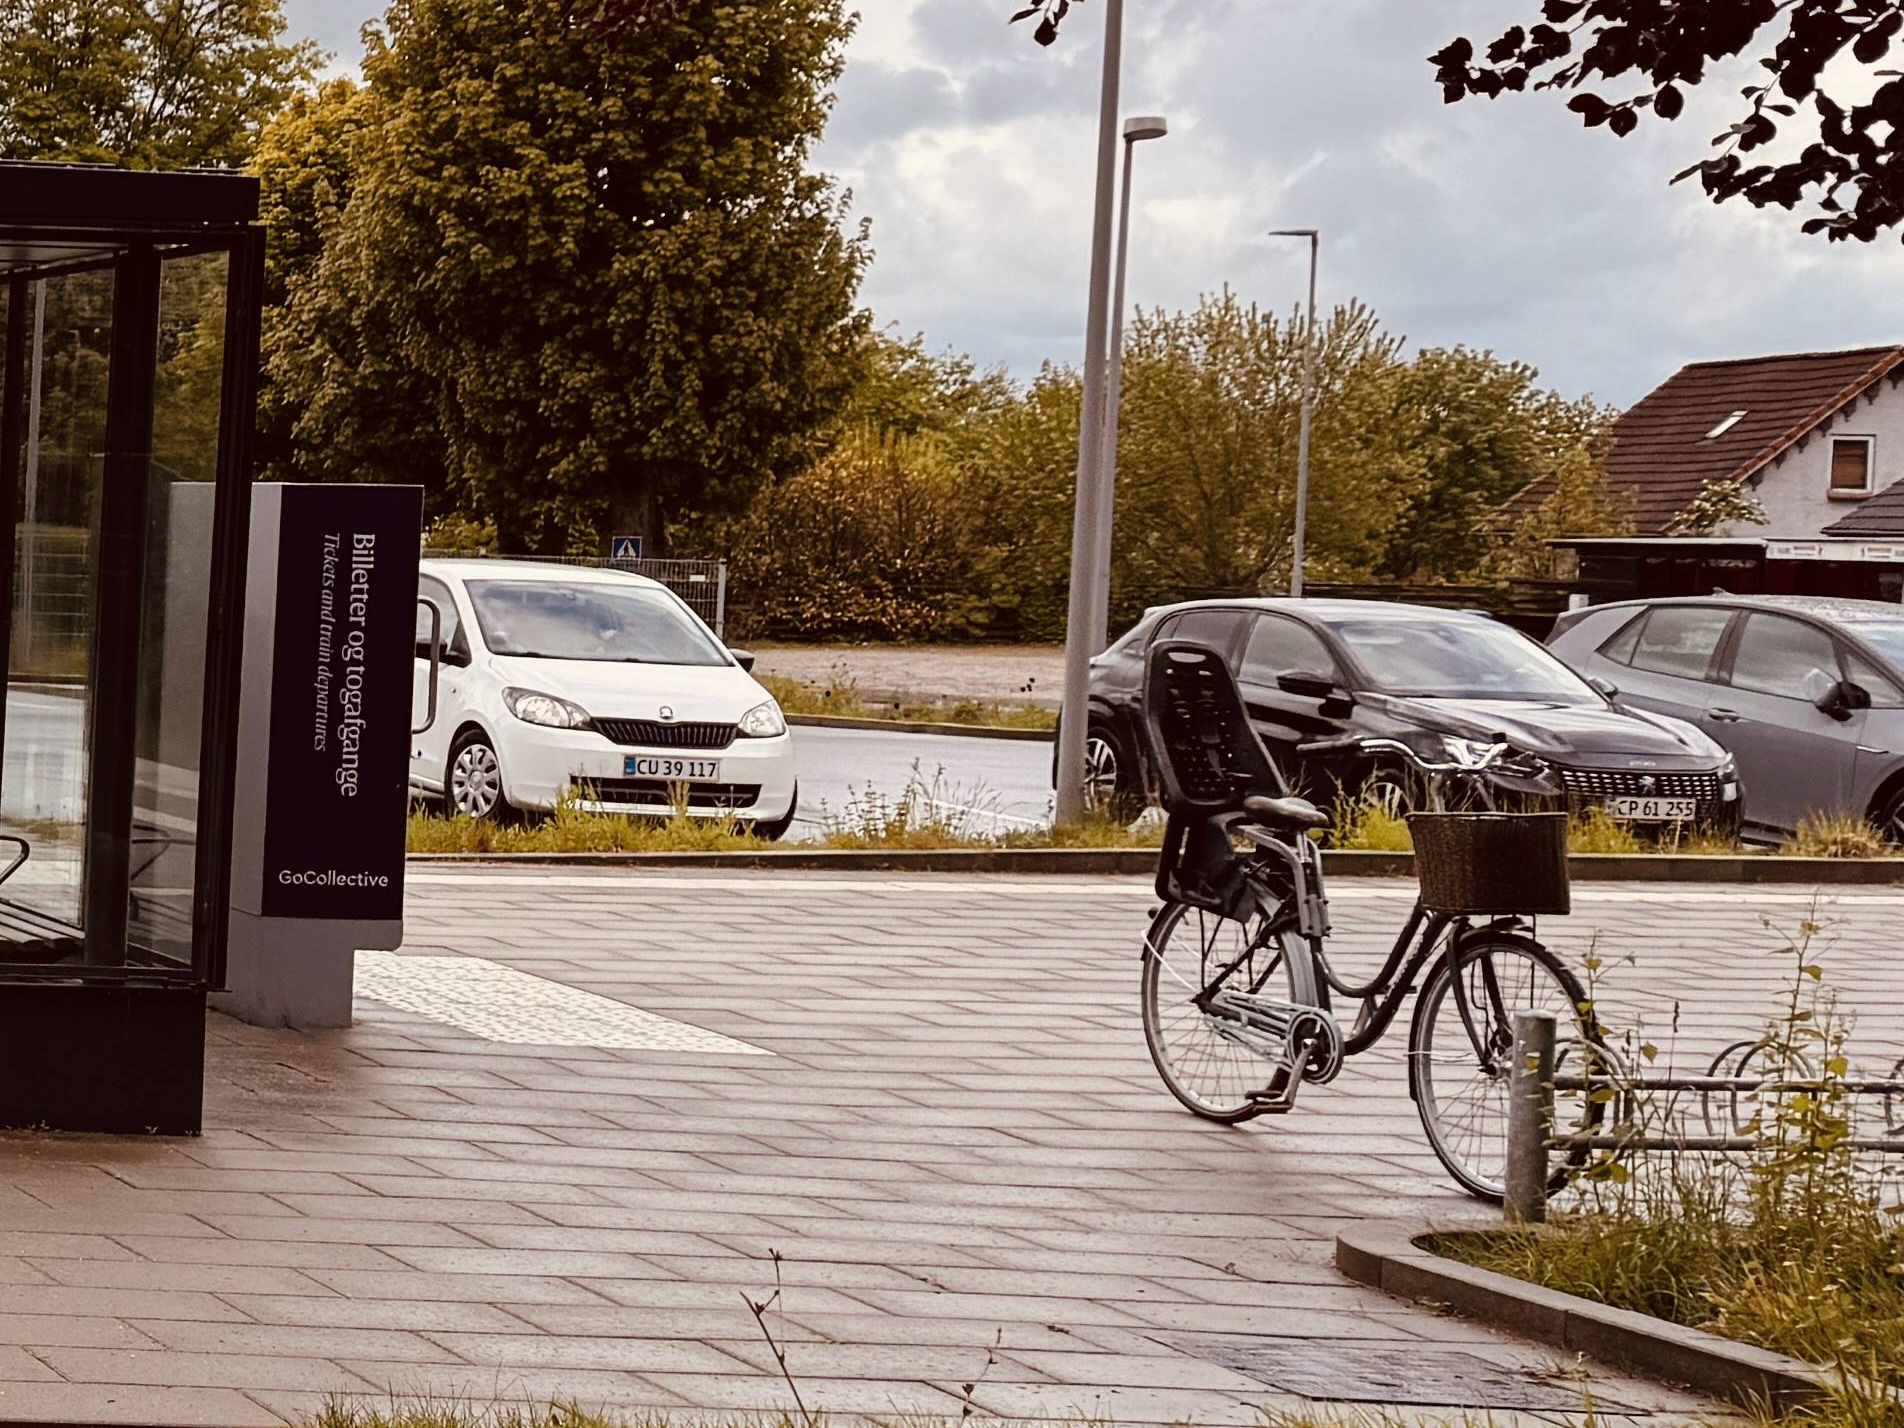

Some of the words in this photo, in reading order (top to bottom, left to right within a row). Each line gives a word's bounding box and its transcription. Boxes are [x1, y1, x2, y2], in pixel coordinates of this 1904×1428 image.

[322, 532, 340, 588] Tickets
[348, 532, 376, 627] Billetter
[320, 589, 336, 622] and
[318, 624, 334, 666] train
[342, 629, 366, 661] og
[313, 667, 334, 752] departures
[335, 666, 367, 797] togafgange
[637, 759, 659, 775] CU
[663, 760, 683, 776] 39
[689, 761, 717, 777] 117
[1617, 800, 1639, 816] CP
[1643, 800, 1660, 816] 61
[1665, 801, 1693, 817] 255
[278, 869, 389, 887] GoCollective
